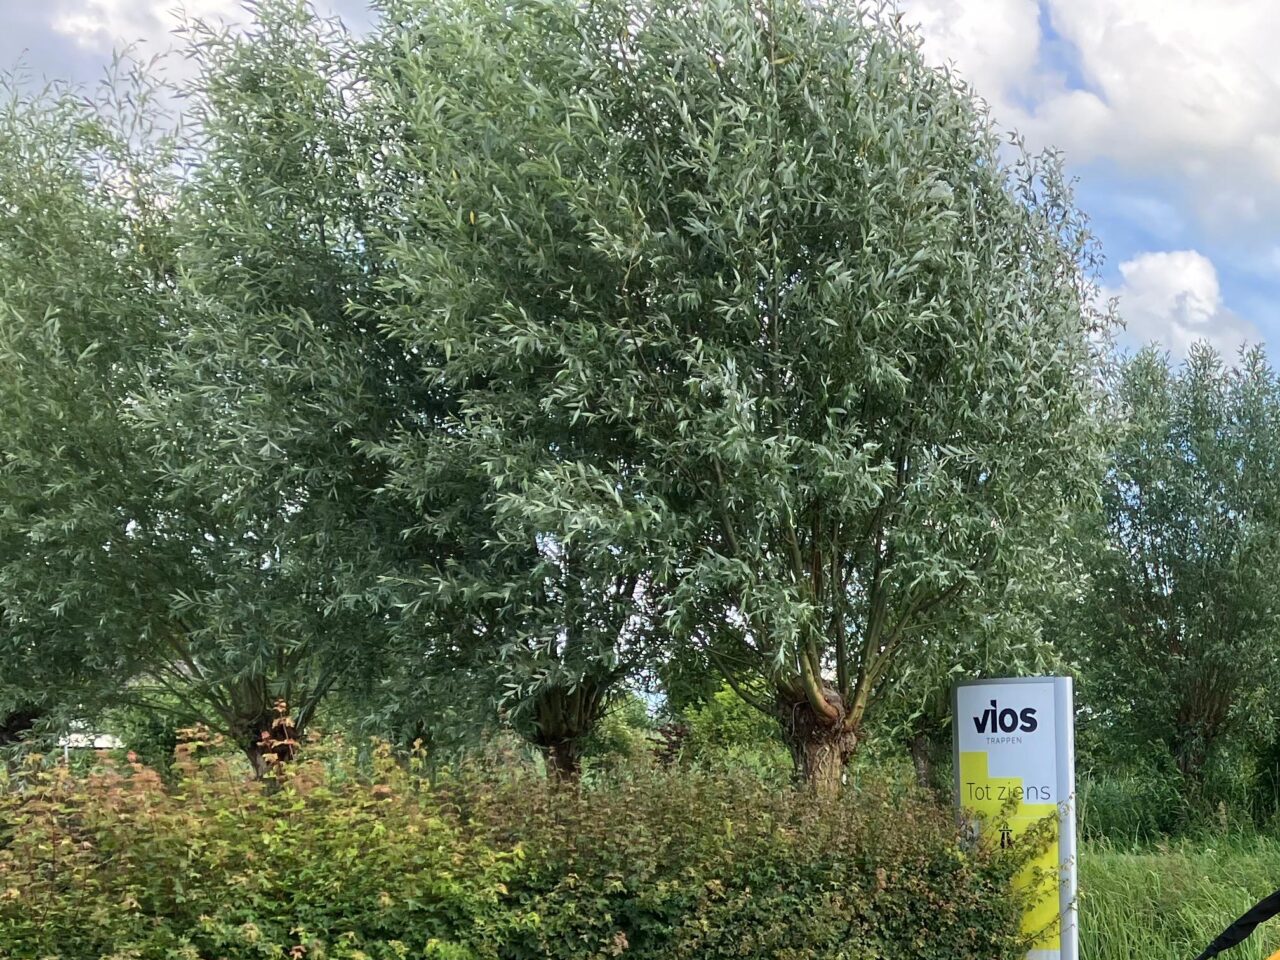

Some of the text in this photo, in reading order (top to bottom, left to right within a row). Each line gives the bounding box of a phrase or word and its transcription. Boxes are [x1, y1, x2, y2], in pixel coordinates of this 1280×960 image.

[973, 699, 1038, 733] vios
[986, 737, 1022, 745] TRAPPEN
[966, 781, 1051, 801] Tot ziens
